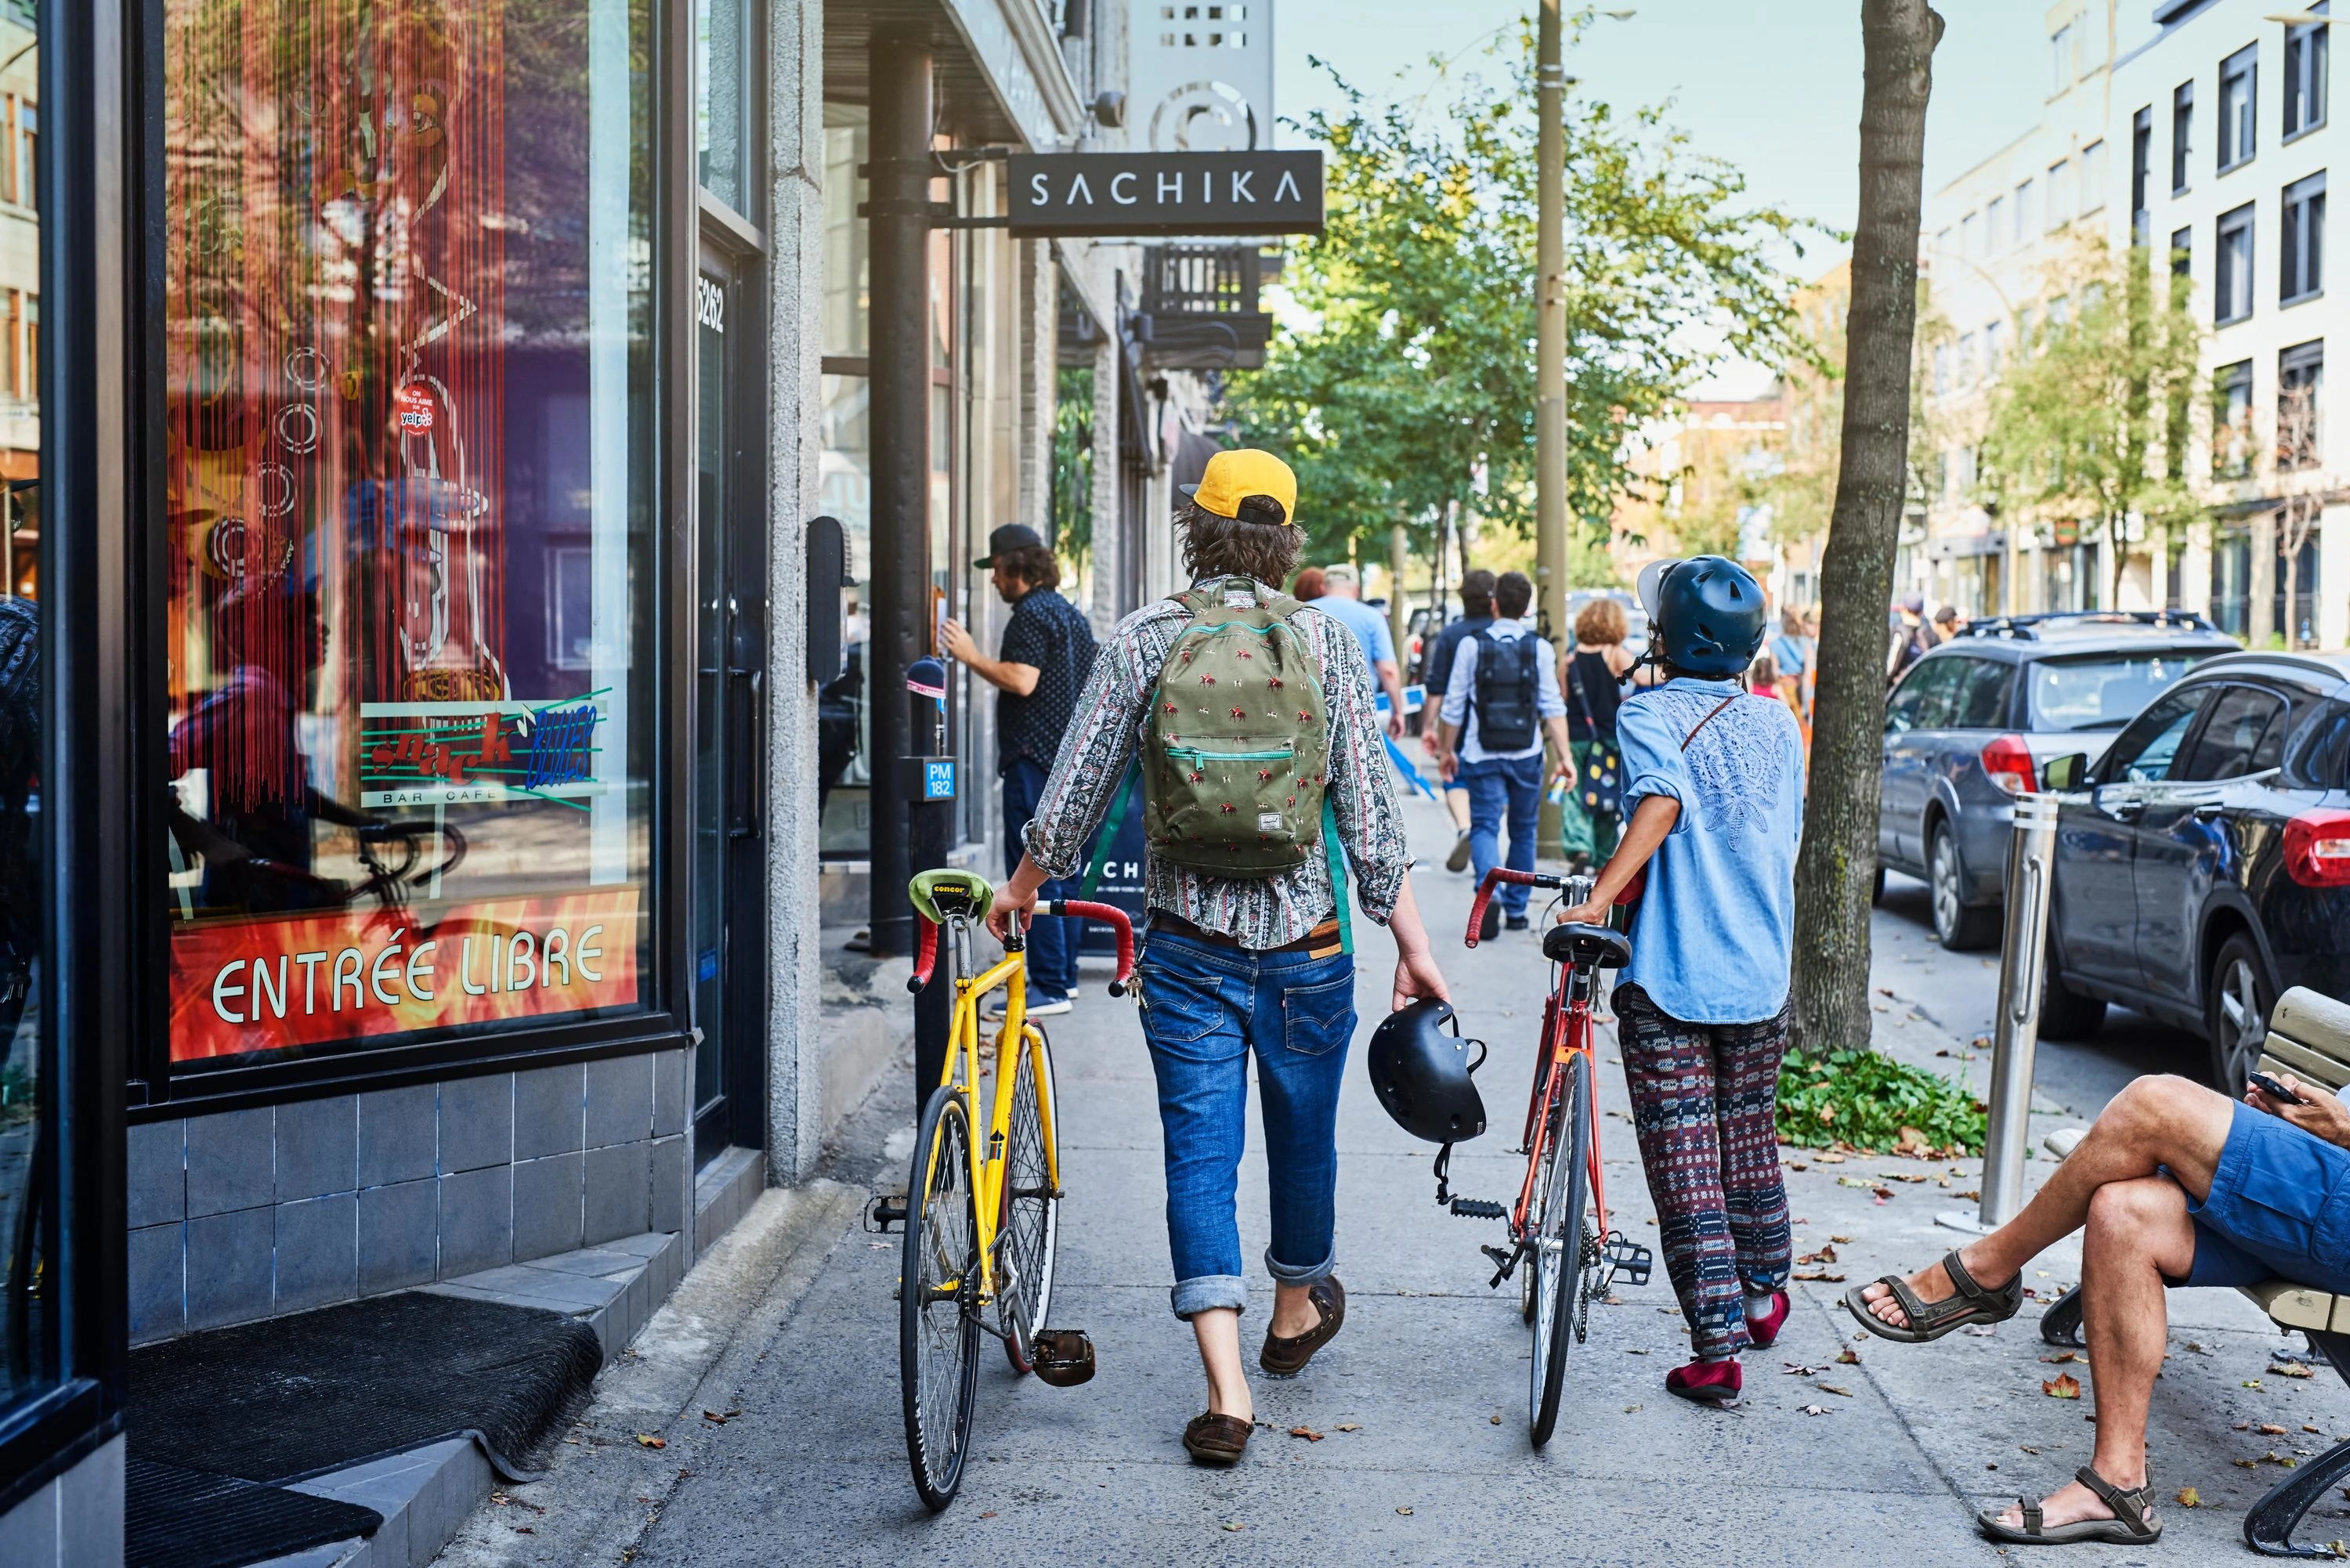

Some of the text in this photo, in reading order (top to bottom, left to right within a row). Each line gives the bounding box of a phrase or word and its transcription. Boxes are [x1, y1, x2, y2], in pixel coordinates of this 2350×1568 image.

[1030, 170, 1302, 206] SACHIKA
[400, 395, 418, 404] NOUS
[400, 411, 423, 428] yelp
[371, 704, 597, 791] snack BLUES
[930, 764, 951, 780] PM
[930, 780, 950, 796] 182
[383, 789, 496, 804] BAR CAFE
[212, 924, 603, 1024] ENTRÉE LIBRE
